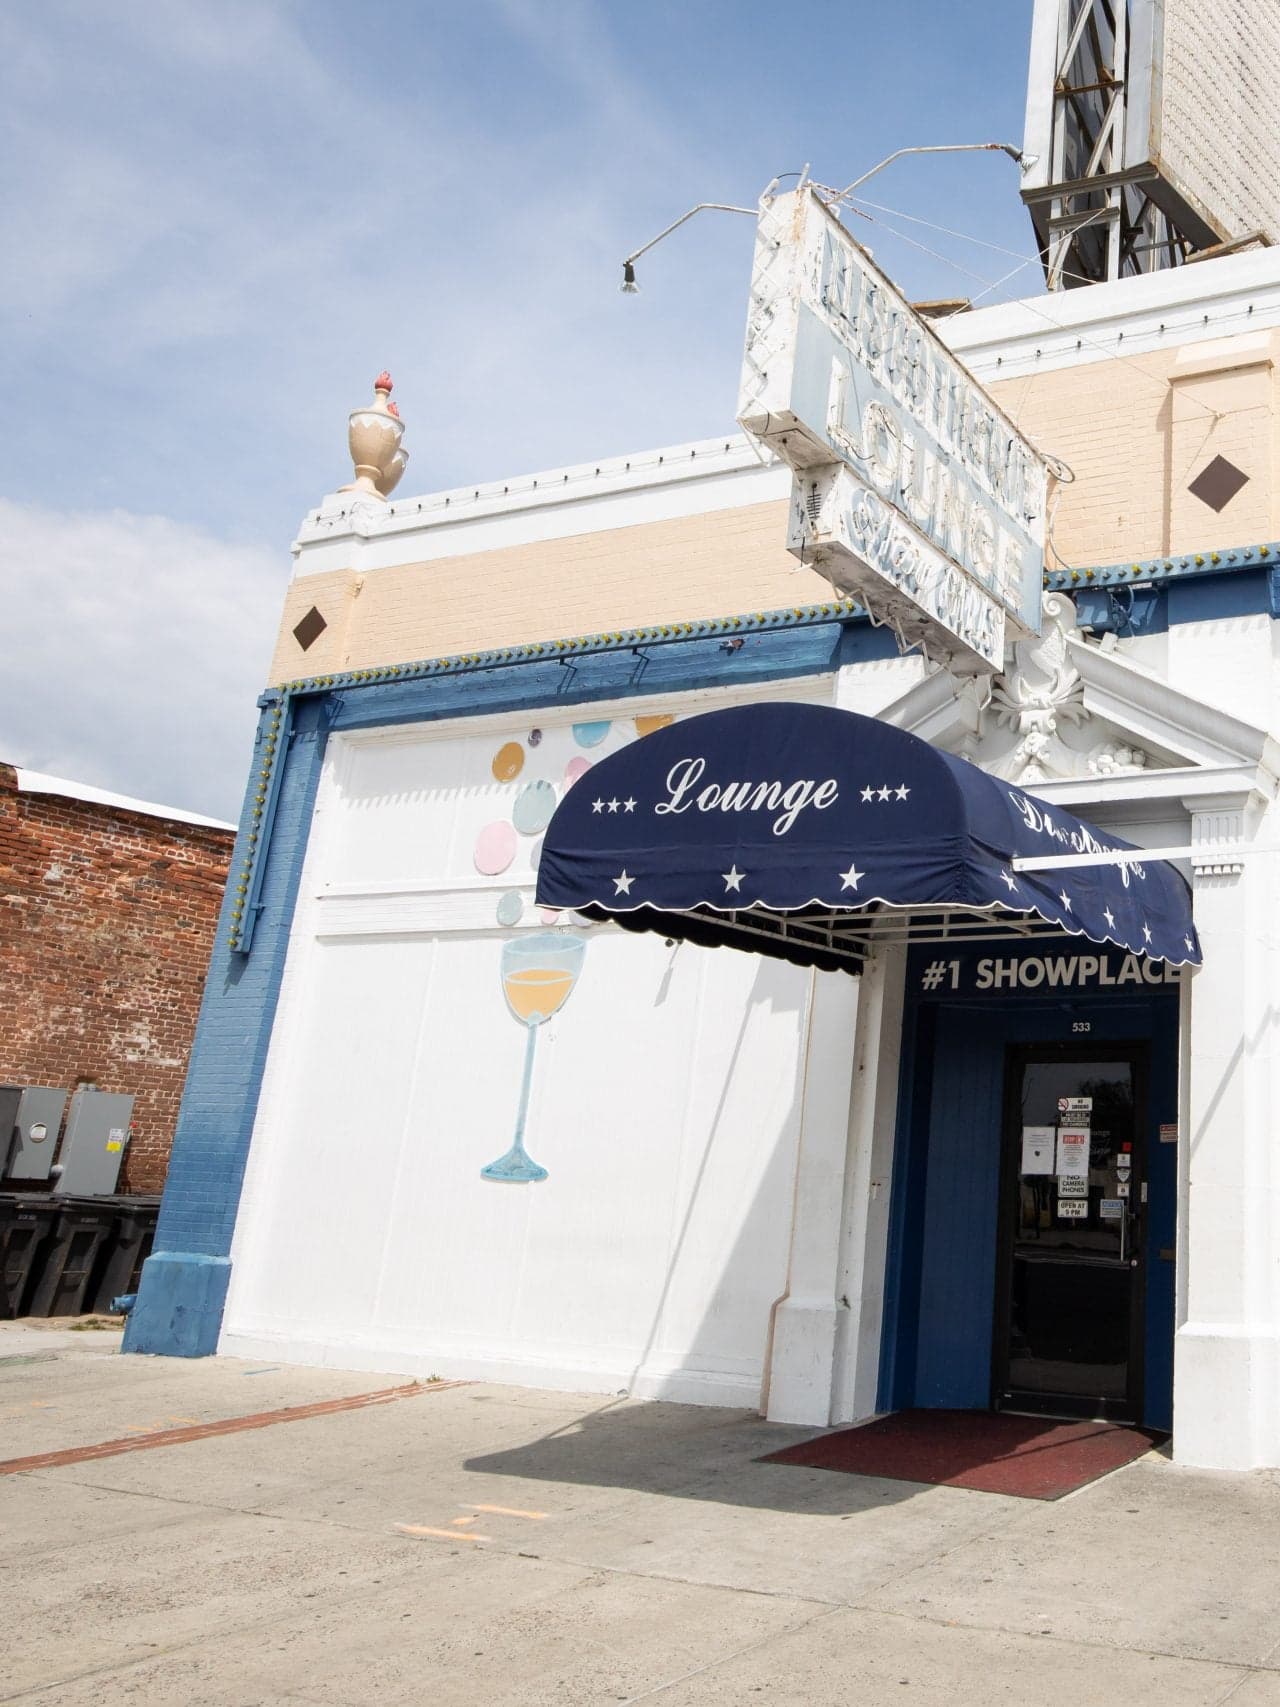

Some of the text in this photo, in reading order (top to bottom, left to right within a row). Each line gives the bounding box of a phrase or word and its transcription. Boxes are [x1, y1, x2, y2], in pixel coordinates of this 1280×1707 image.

[825, 350, 1023, 615] LOUNGE
[654, 757, 839, 836] Lounge
[921, 954, 1181, 990] #1 SHOWPLACE
[1072, 1022, 1091, 1032] 533
